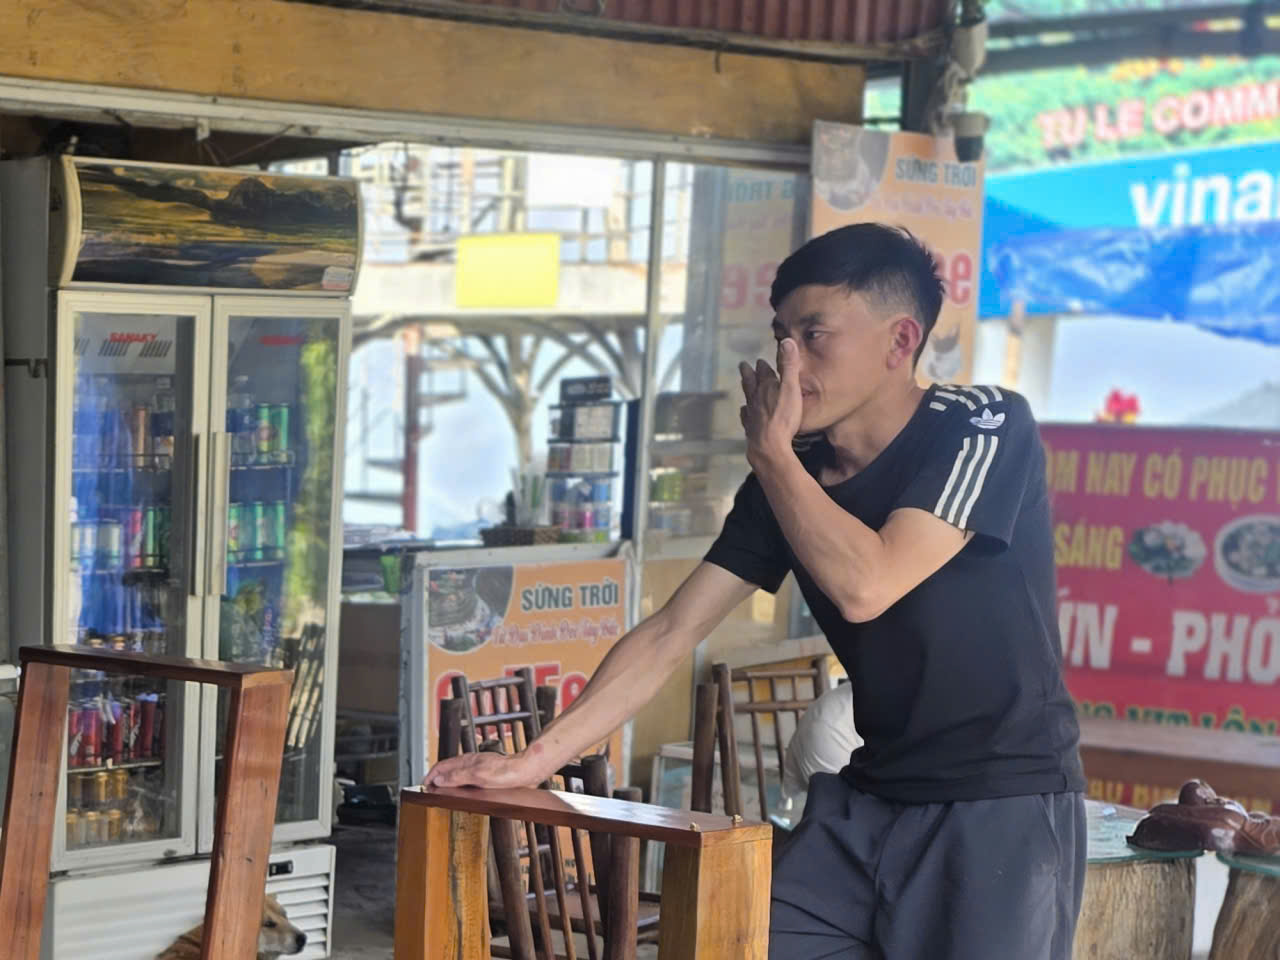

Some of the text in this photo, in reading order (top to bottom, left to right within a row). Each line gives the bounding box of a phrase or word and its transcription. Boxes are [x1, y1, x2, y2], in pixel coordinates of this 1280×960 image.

[1130, 162, 1280, 227] vina
[1085, 451, 1138, 497] NAY
[1143, 446, 1184, 501] CÓ
[1188, 456, 1269, 511] PHỤC
[1054, 515, 1125, 569] SÁNG
